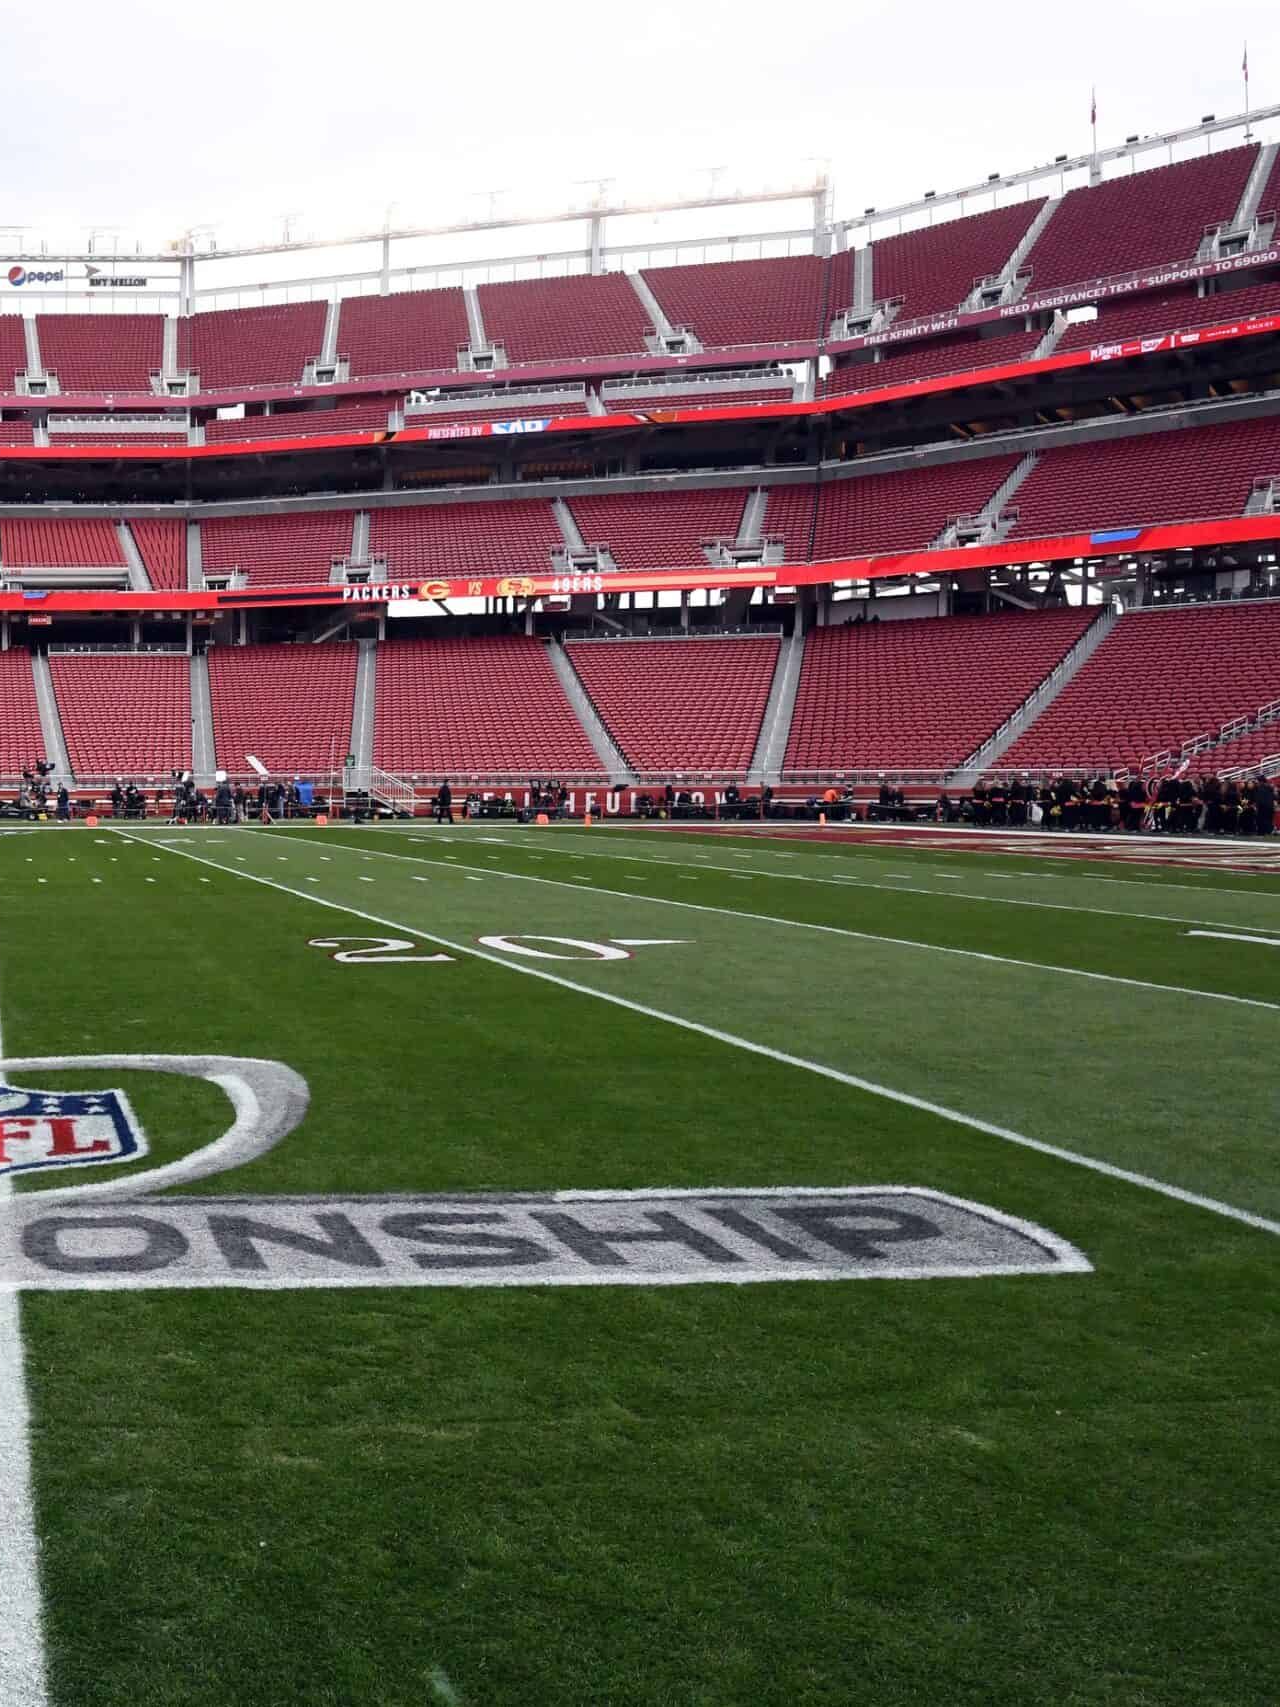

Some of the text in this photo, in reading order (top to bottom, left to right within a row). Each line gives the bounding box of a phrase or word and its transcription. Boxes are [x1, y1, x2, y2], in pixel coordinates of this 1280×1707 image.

[27, 270, 64, 285] pepsi
[89, 278, 147, 287] BNY MELLON
[1000, 303, 1030, 317] NEED
[1031, 286, 1107, 310] ASSISTANCE?
[1109, 280, 1140, 294] TEXT
[1214, 260, 1233, 272] TO
[1234, 251, 1278, 268] 69050
[889, 325, 930, 342] XFINITY
[931, 318, 958, 331] WI-FI
[343, 584, 410, 601] PACKERS
[468, 581, 483, 596] VS
[551, 575, 603, 593] 49ERS
